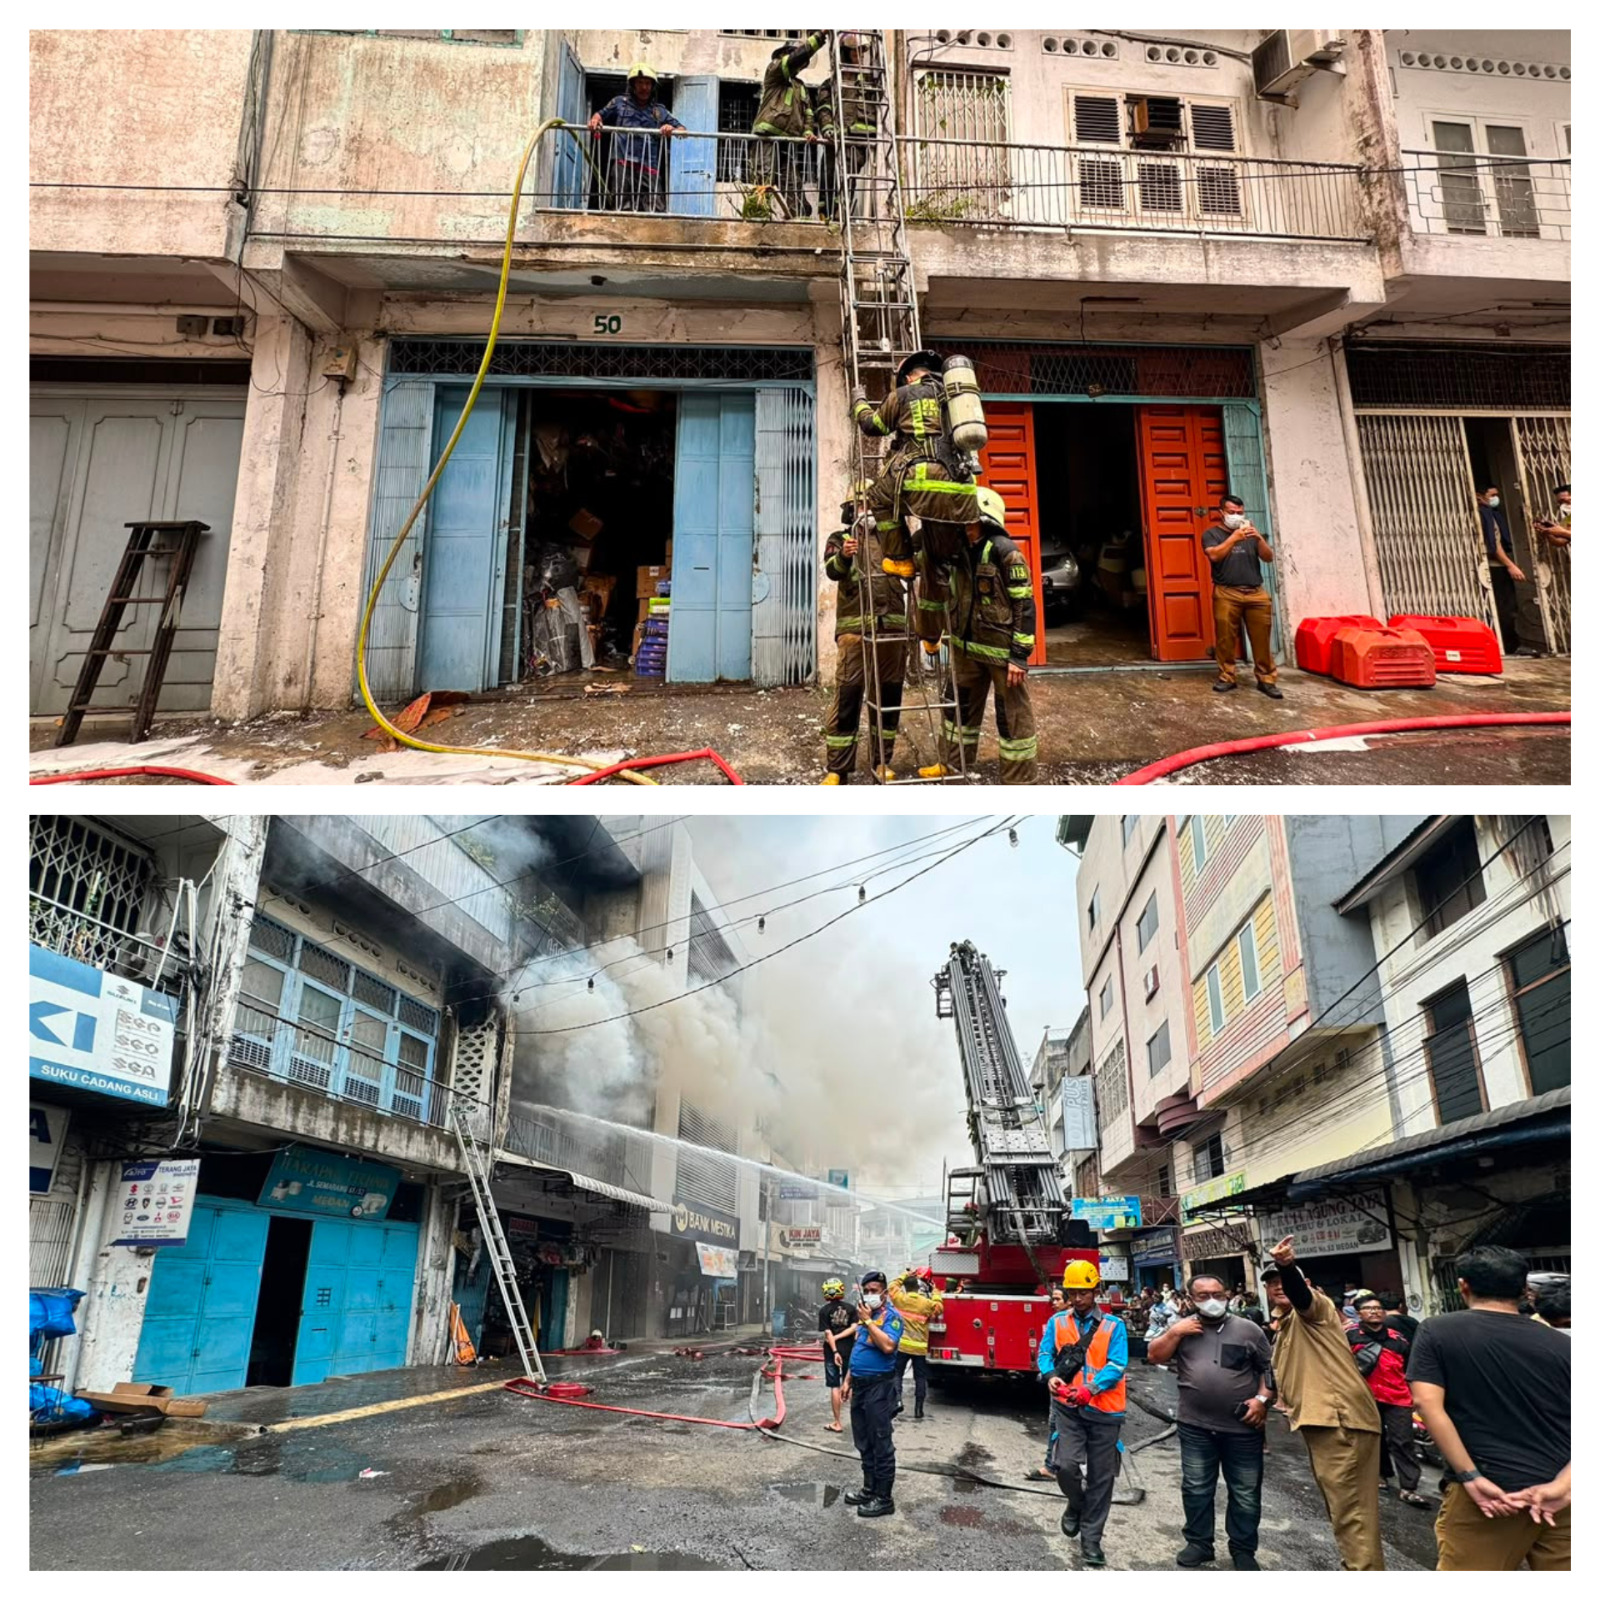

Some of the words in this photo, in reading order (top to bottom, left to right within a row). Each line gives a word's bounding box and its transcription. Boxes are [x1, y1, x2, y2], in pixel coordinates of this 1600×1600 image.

[593, 315, 622, 334] 50
[40, 1064, 78, 1081] SUKU
[80, 1074, 132, 1094] CADANG
[133, 1089, 159, 1101] ASLI
[158, 1165, 182, 1173] TERANG
[1307, 1201, 1346, 1221] AGUNG
[1327, 1213, 1365, 1227] LOKAL
[689, 1211, 710, 1233] BANK
[711, 1218, 736, 1240] MESTIKA
[803, 1229, 820, 1238] JAYA
